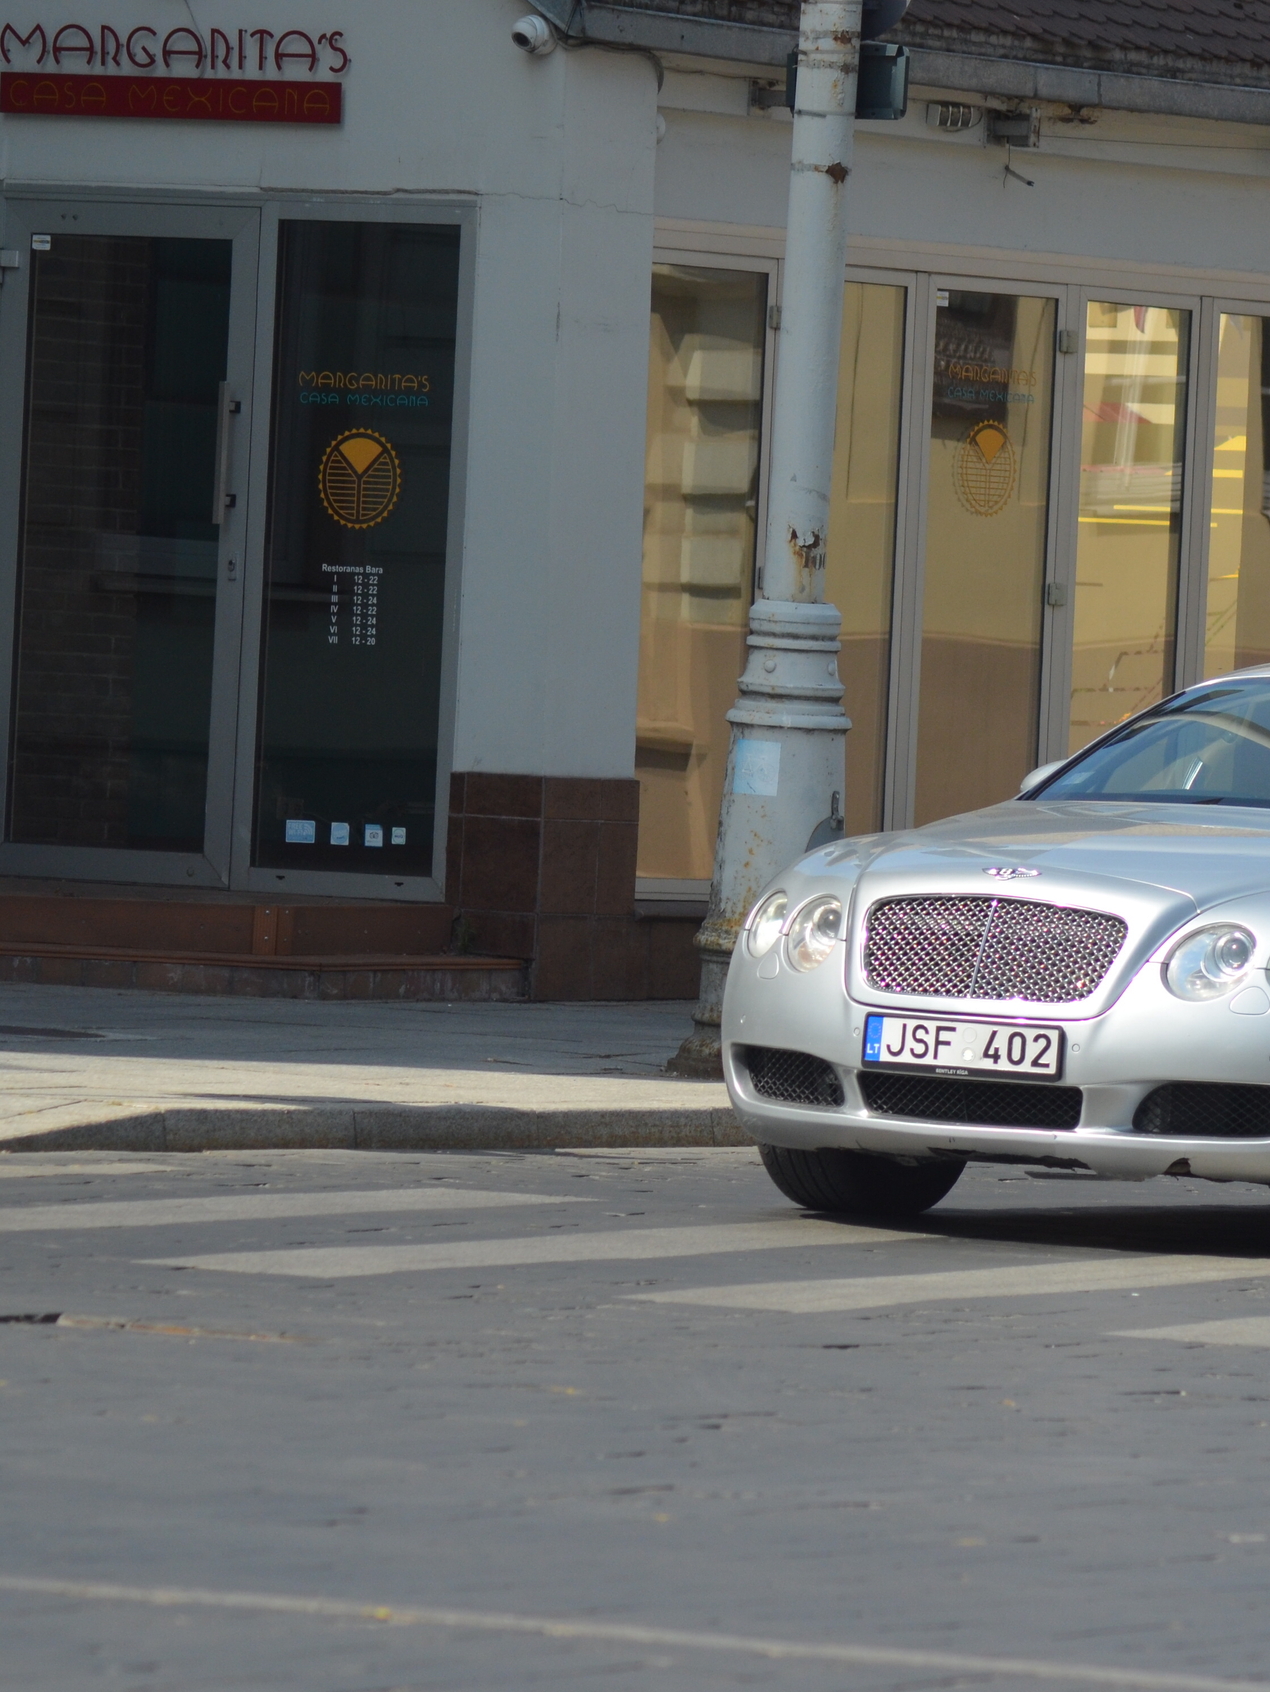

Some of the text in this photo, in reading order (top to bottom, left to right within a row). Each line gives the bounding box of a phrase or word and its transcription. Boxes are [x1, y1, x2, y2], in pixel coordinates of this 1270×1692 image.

[0, 23, 349, 73] MARGARITA'S
[10, 79, 331, 116] CASA MEXICANA
[298, 370, 430, 392] MARGARITA'S
[300, 392, 429, 407] CASA MEXICANA
[948, 386, 1035, 404] CASA MEXICANA
[322, 564, 383, 573] Restoranas Bara
[331, 605, 338, 613] IV
[331, 615, 337, 623] V
[866, 1044, 880, 1054] LT
[886, 1023, 1051, 1068] JSF 402
